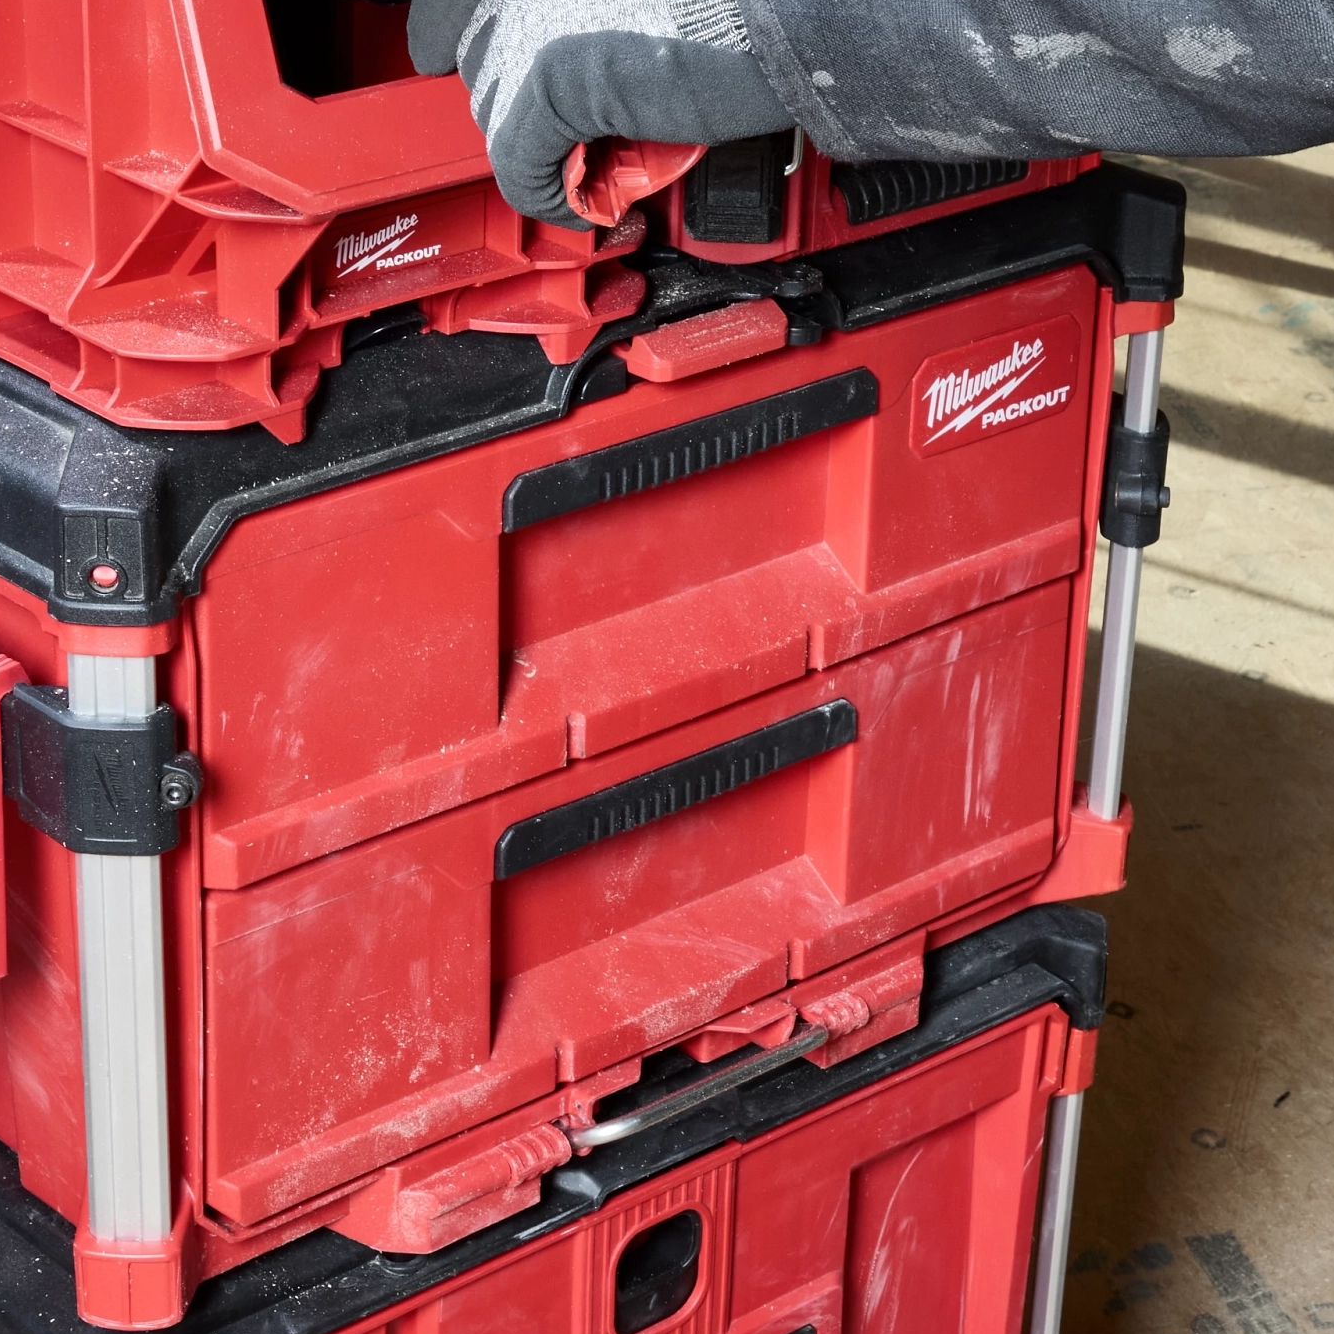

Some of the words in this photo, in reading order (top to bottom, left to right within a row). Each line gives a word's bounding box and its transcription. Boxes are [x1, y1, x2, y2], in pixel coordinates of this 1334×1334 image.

[334, 213, 419, 269] Milwaukee
[376, 244, 442, 271] PACKOUT
[921, 338, 1044, 428] Milwaukee
[981, 385, 1071, 430] PACKOUT
